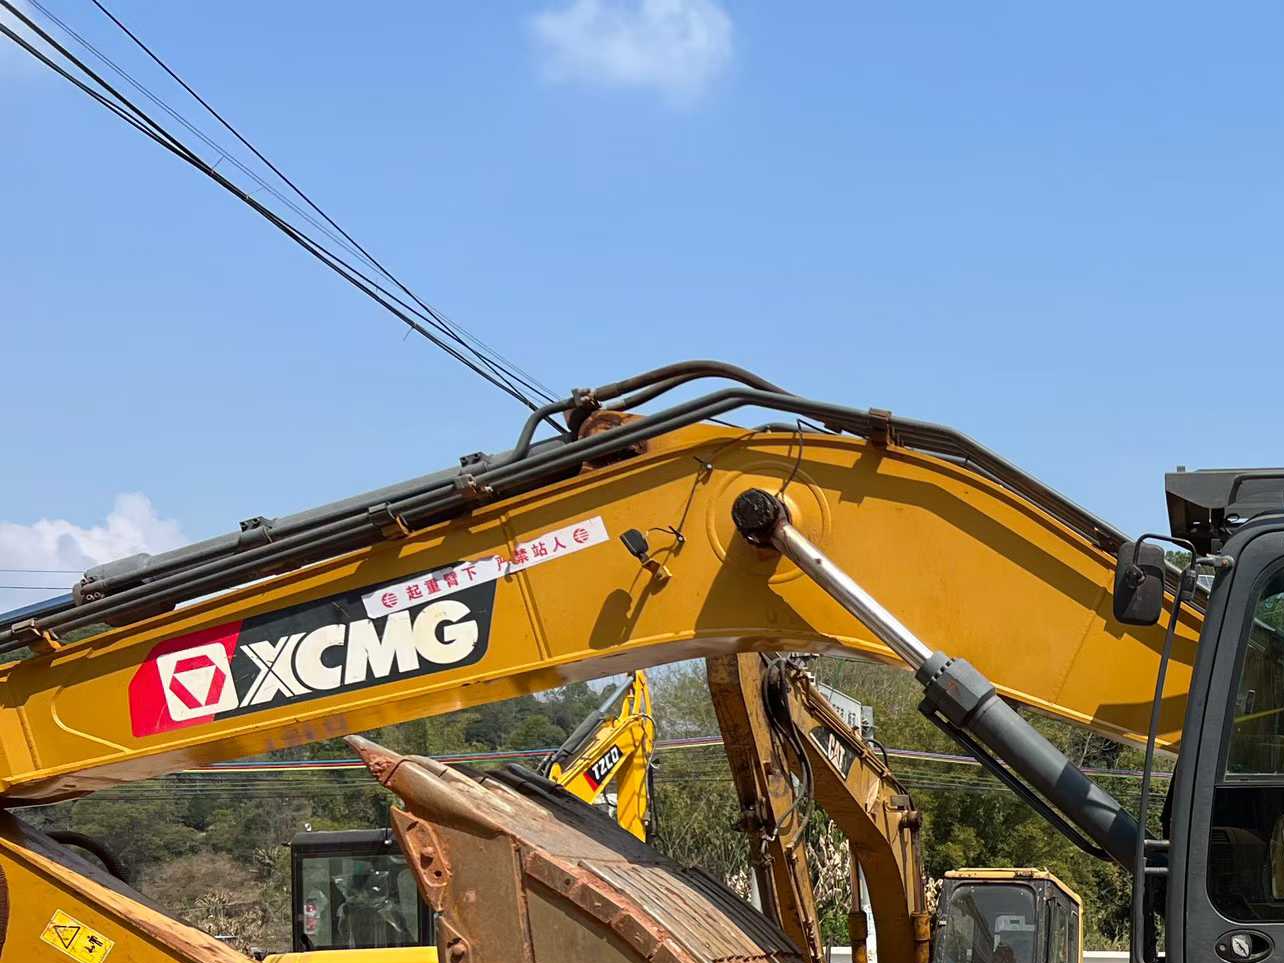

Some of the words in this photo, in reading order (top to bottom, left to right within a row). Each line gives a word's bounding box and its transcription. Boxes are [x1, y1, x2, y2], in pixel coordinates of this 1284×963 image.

[405, 563, 478, 601] 起重臂下
[496, 535, 567, 573] 严禁站人
[239, 599, 479, 709] XCMG
[591, 746, 620, 780] TZCO
[827, 732, 846, 771] CAT
